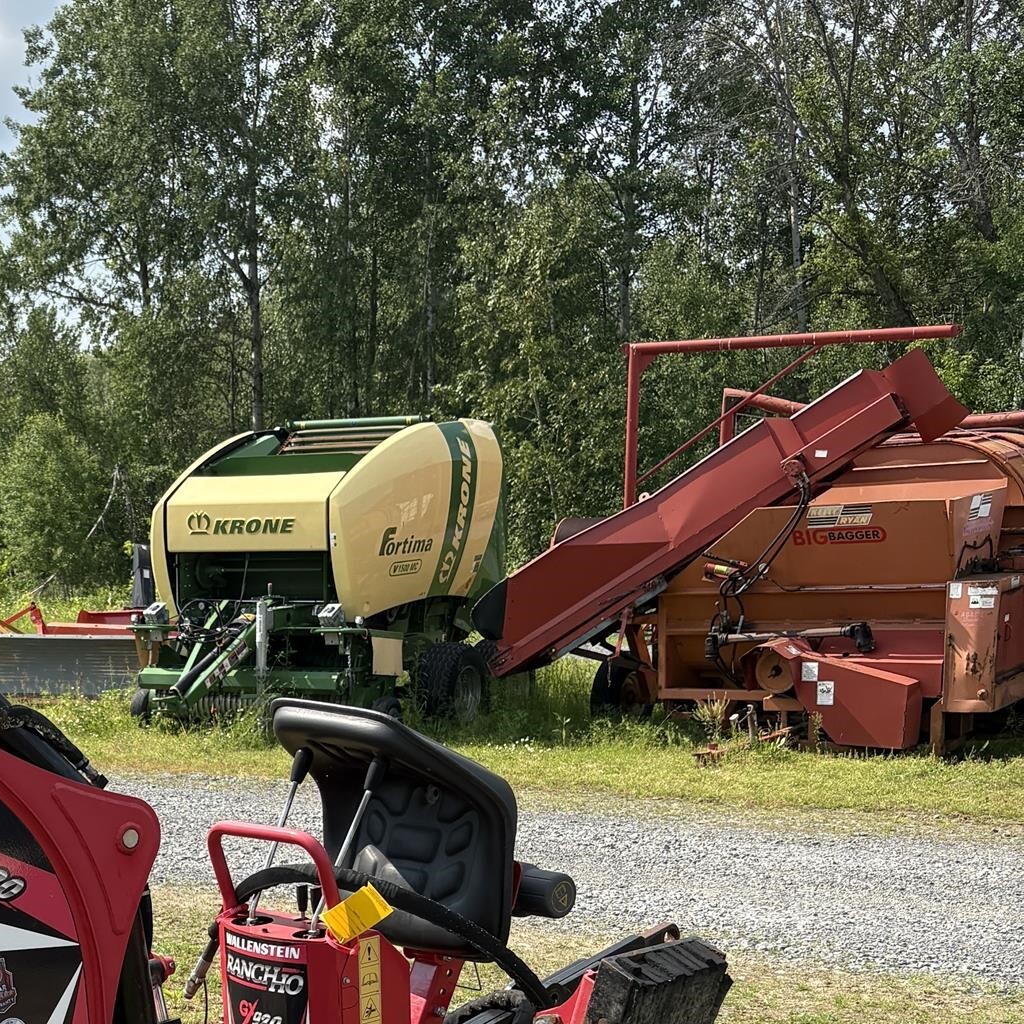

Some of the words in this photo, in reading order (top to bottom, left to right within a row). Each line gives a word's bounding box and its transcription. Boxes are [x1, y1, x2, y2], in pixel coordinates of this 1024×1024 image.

[451, 436, 471, 552] KRONE
[213, 516, 296, 535] KRONE
[839, 514, 869, 525] RYAN
[379, 526, 433, 556] Fortima
[792, 529, 828, 546] BIG
[828, 529, 881, 541] BAGGER
[226, 932, 300, 960] WALLENSTEIN
[226, 954, 304, 996] RANCHO
